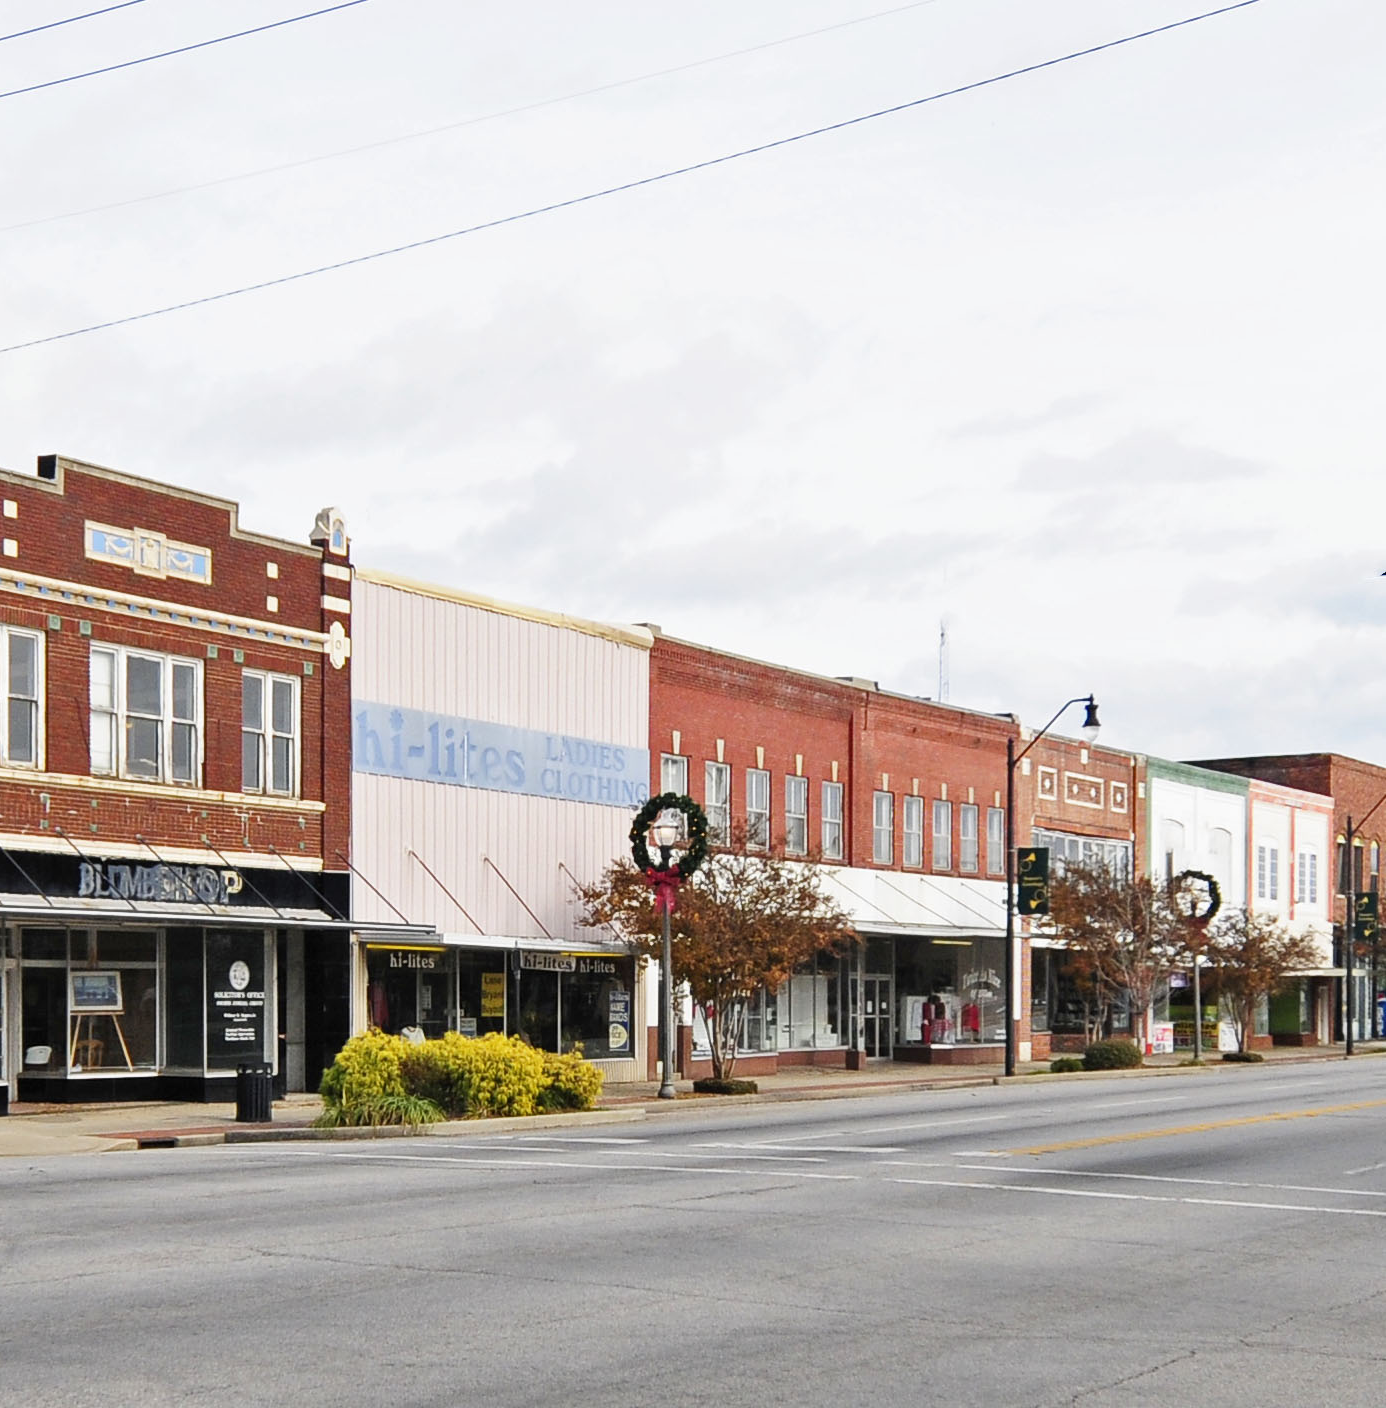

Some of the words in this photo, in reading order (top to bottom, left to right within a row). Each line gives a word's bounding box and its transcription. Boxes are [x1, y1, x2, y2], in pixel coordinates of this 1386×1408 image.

[355, 708, 526, 787] hi-lites
[546, 736, 626, 772] LADIES
[541, 768, 648, 804] CLOTHING
[389, 952, 435, 969] hi-lites
[524, 955, 573, 971] hi-lites
[580, 958, 616, 974] hi-lites
